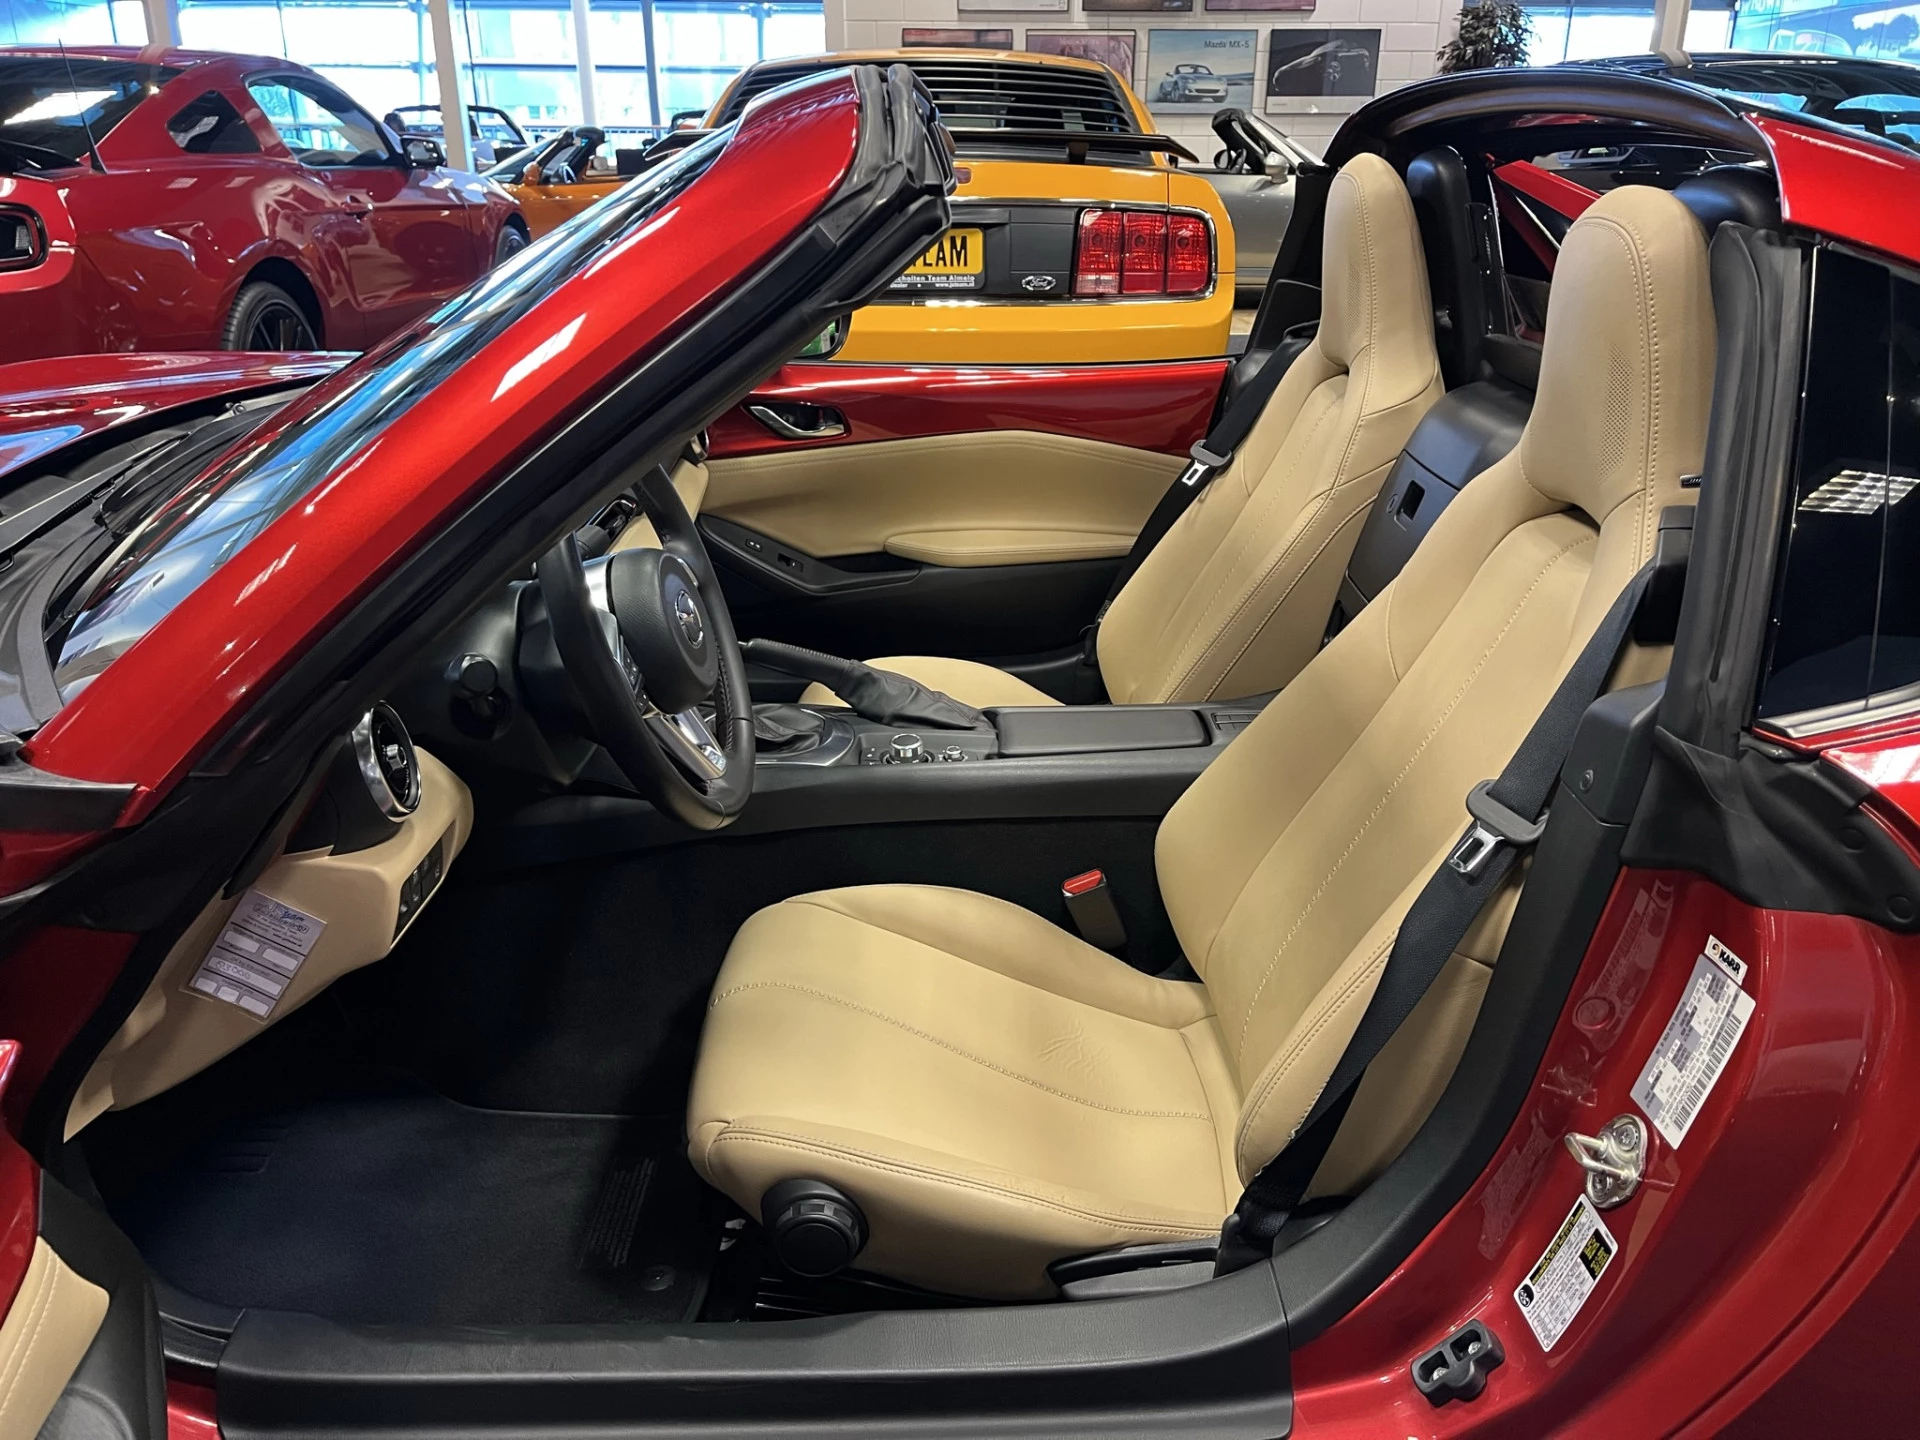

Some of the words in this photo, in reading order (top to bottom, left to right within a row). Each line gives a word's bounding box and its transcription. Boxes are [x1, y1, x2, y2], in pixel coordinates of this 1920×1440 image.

[1204, 40, 1226, 49] Mazda
[1229, 40, 1250, 49] MX-5
[1718, 948, 1741, 974] KARR
